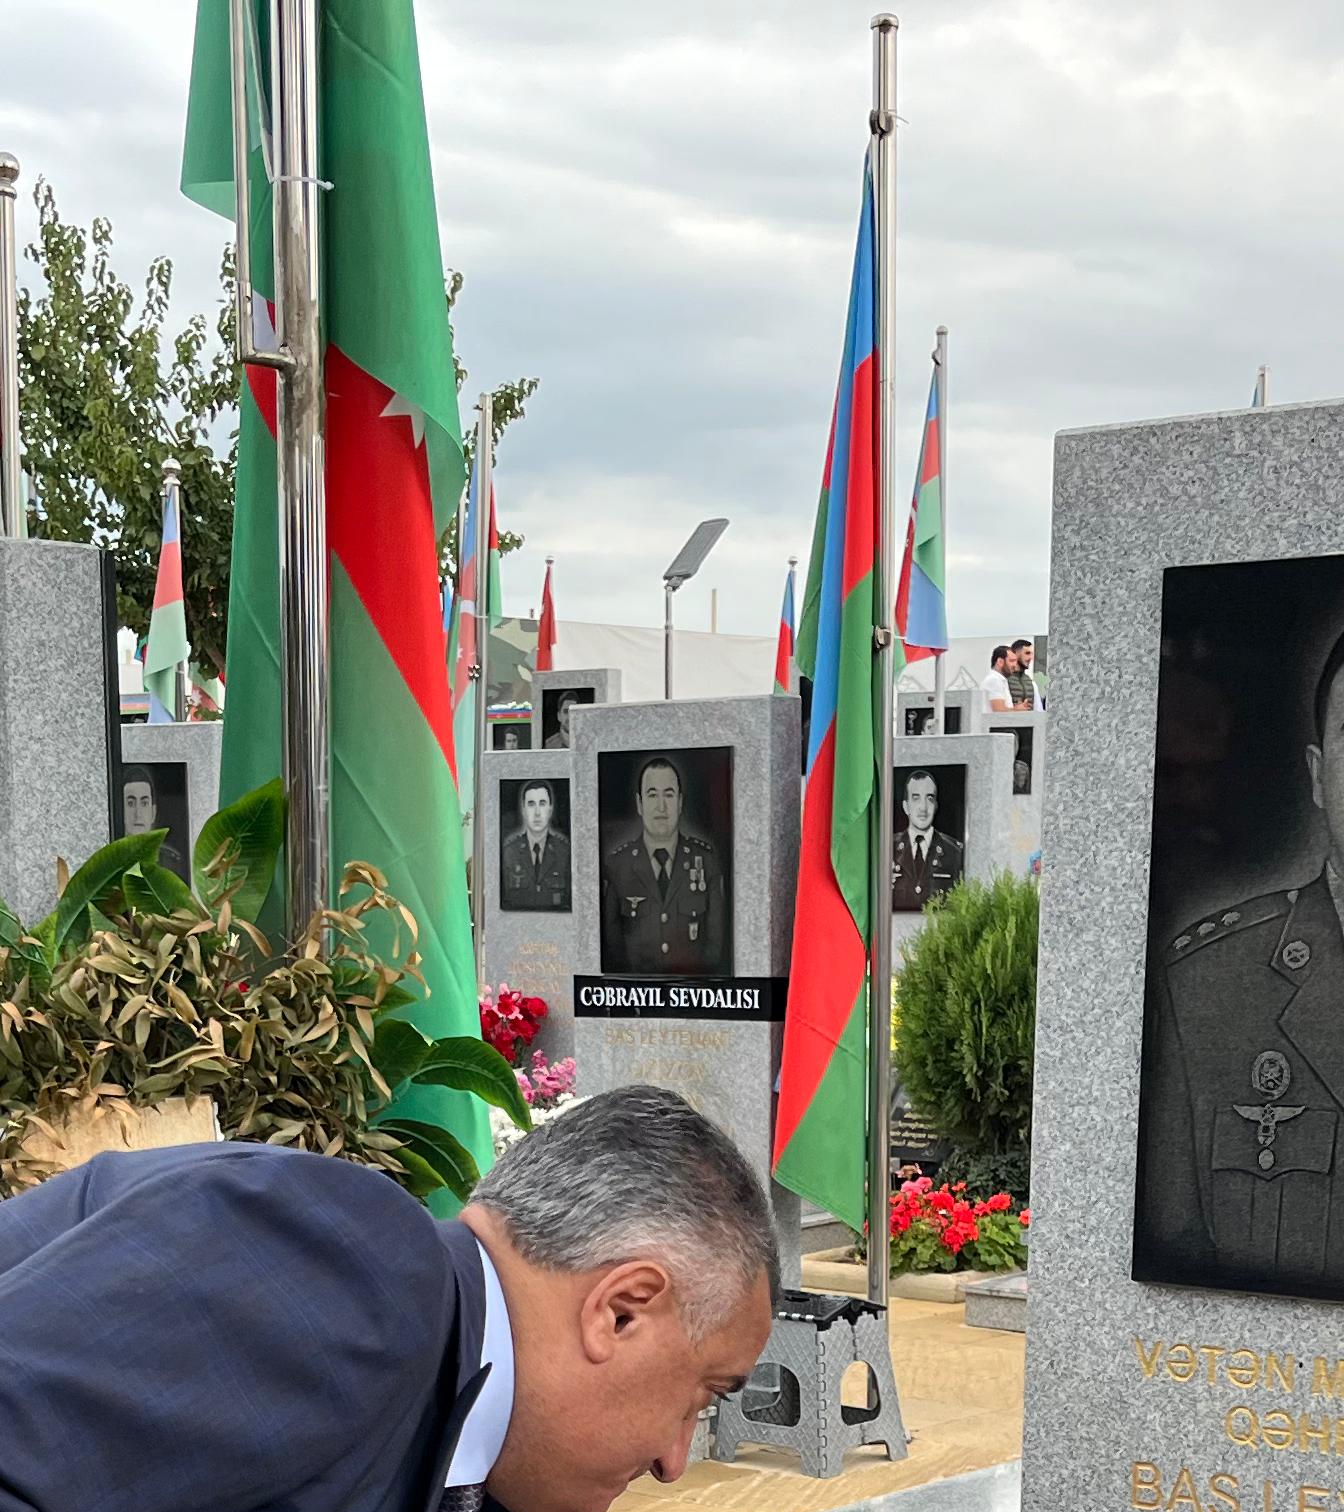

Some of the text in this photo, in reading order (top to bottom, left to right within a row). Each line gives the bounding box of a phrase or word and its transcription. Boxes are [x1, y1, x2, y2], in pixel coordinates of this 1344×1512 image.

[580, 985, 665, 1008] CƏBRAYIL
[669, 987, 761, 1010] SEVDALISI
[1132, 1336, 1296, 1393] VƏTƏN
